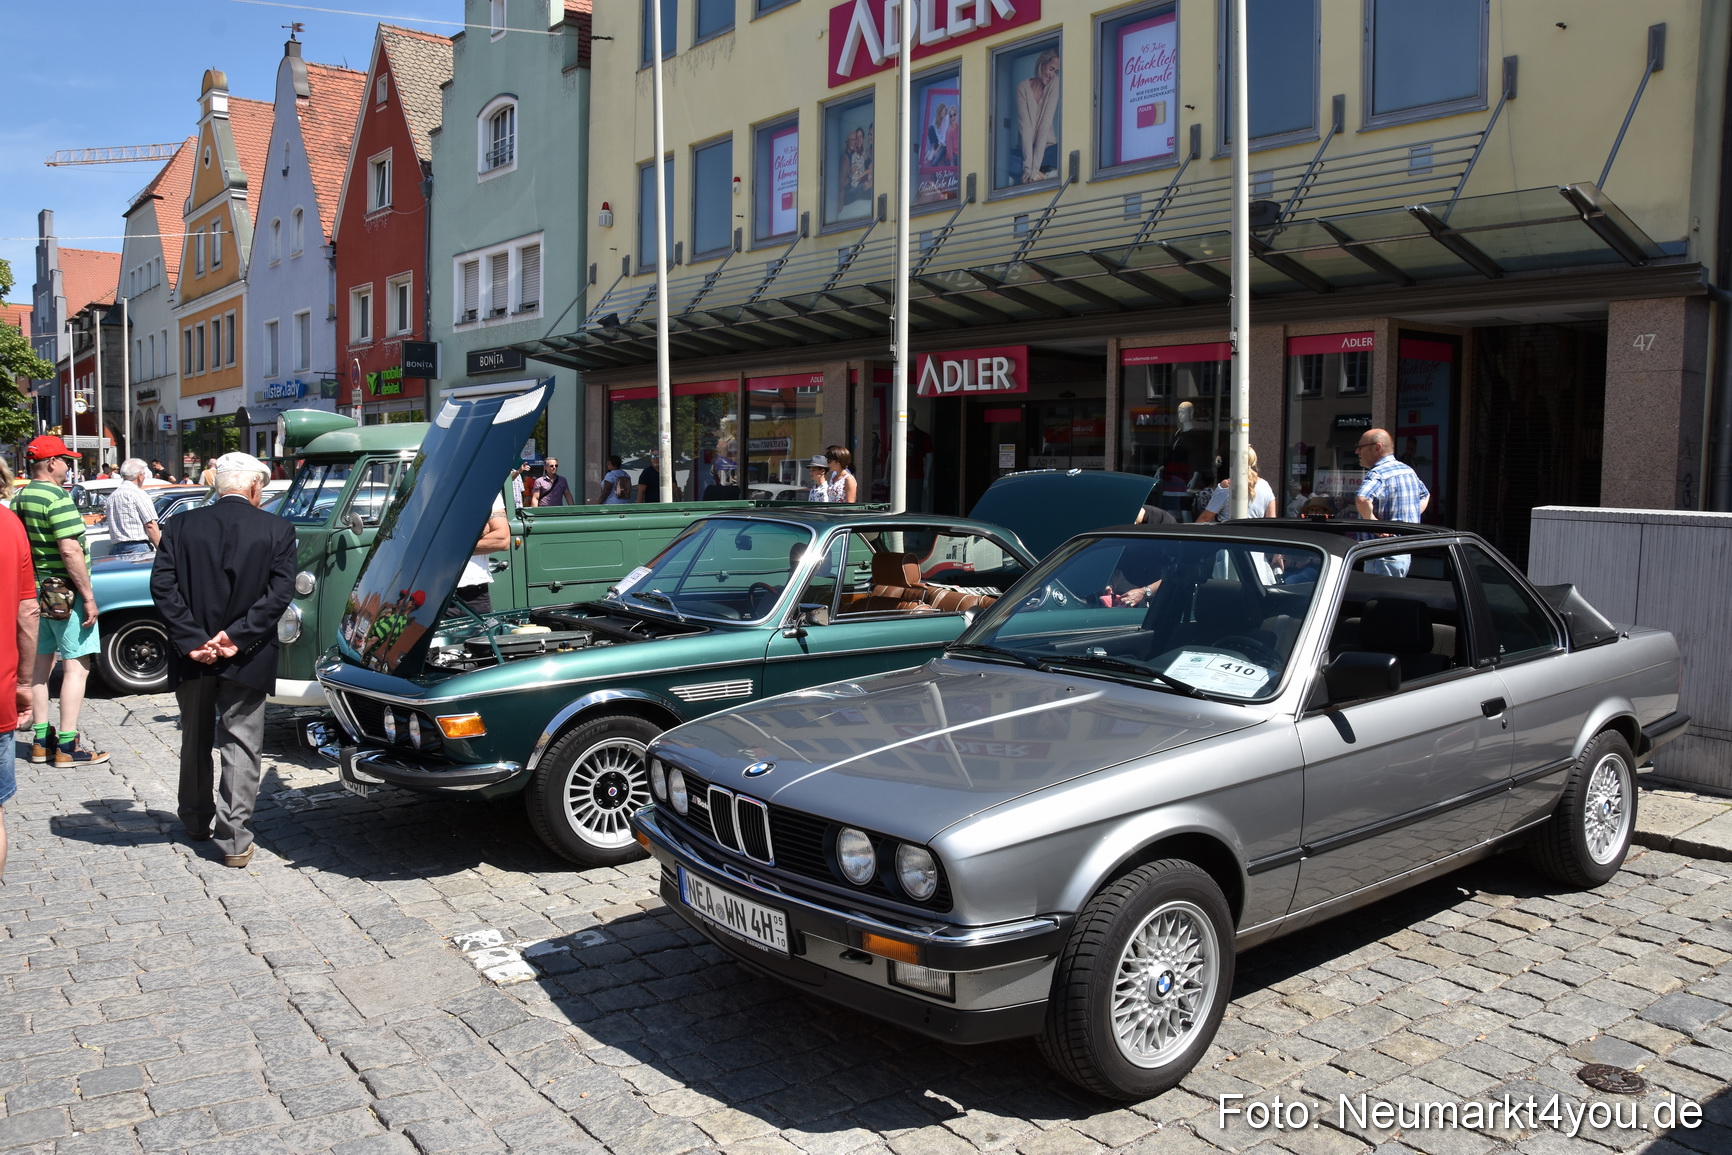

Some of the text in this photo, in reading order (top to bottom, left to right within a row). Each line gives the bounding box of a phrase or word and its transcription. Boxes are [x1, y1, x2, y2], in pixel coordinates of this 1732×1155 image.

[1129, 63, 1175, 92] Momente
[1138, 105, 1152, 113] ADLER
[1341, 336, 1374, 348] ADLER
[1632, 333, 1656, 351] 47
[406, 359, 434, 370] BONITA
[478, 351, 505, 369] BONITA
[916, 353, 1013, 396] ADLER
[381, 381, 401, 395] debitel
[1219, 662, 1256, 676] 410
[563, 722, 610, 761] MICHELIN
[686, 875, 775, 943] NEA WN 4H
[773, 915, 784, 926] 05
[777, 936, 786, 948] 10
